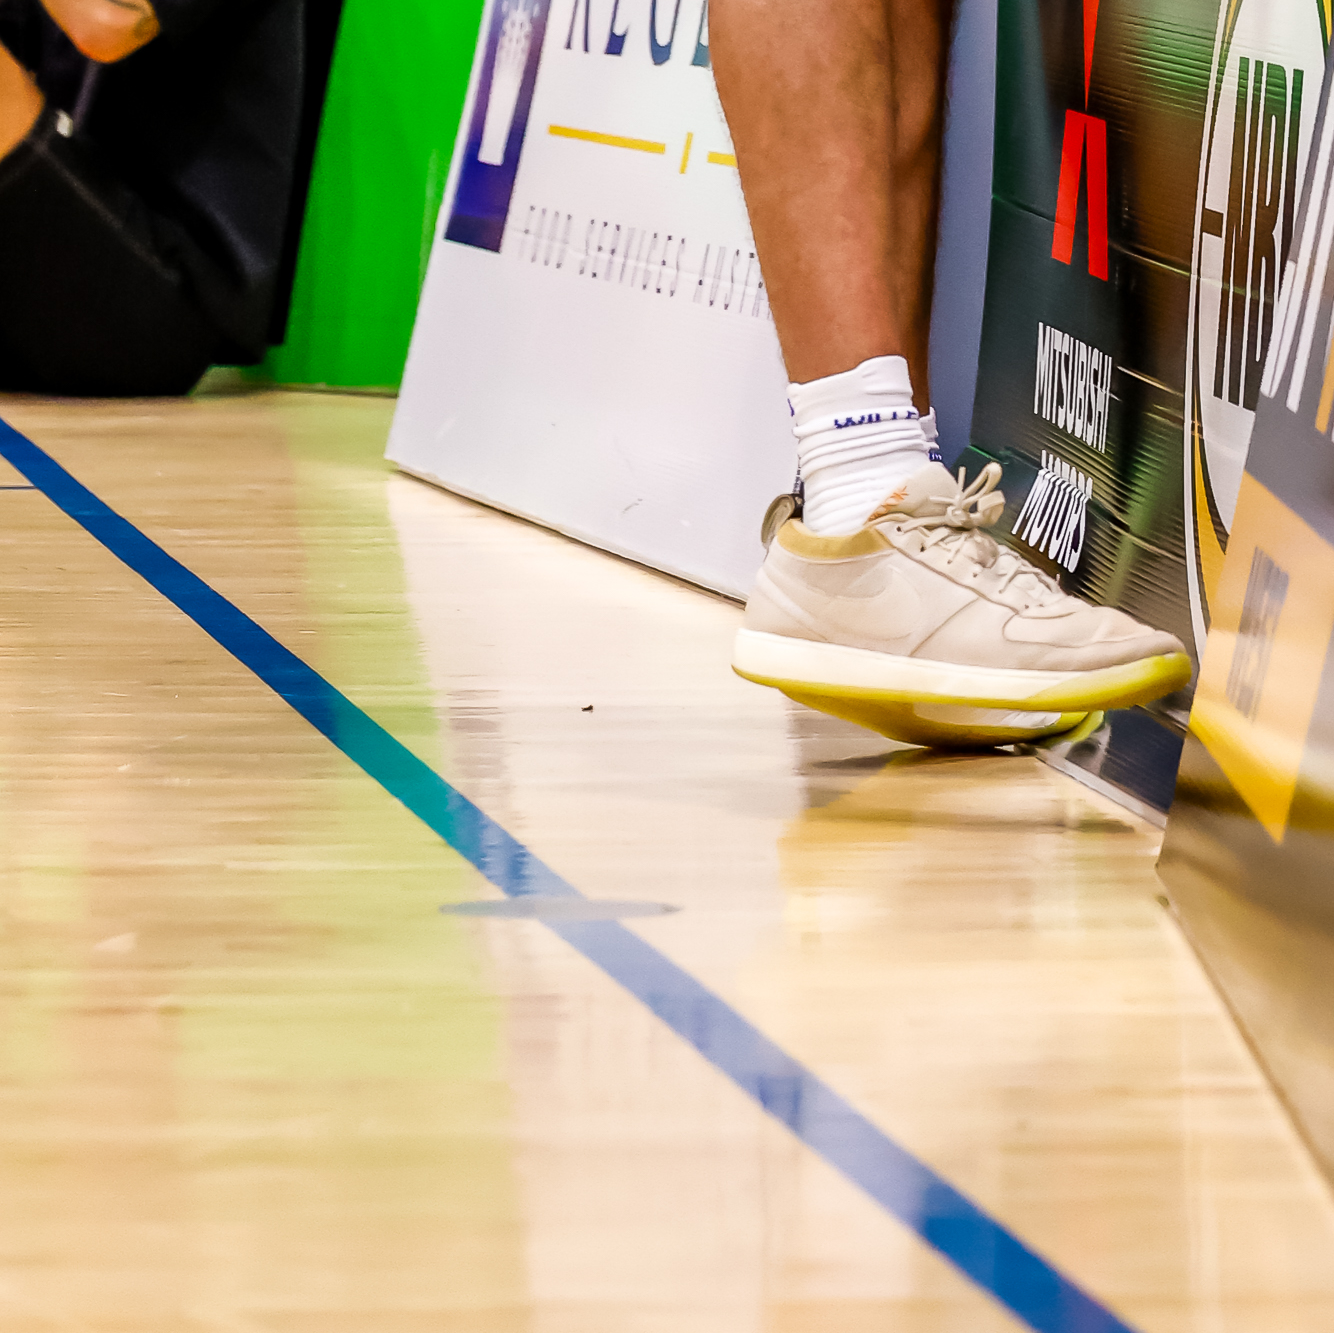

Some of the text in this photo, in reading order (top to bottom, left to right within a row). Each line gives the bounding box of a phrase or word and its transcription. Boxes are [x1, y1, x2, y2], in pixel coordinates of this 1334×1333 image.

[578, 219, 687, 298] SERVICES
[692, 243, 774, 321] AUST
[1034, 321, 1113, 455] MITSUBISHI
[1011, 449, 1094, 575] MOTORS
